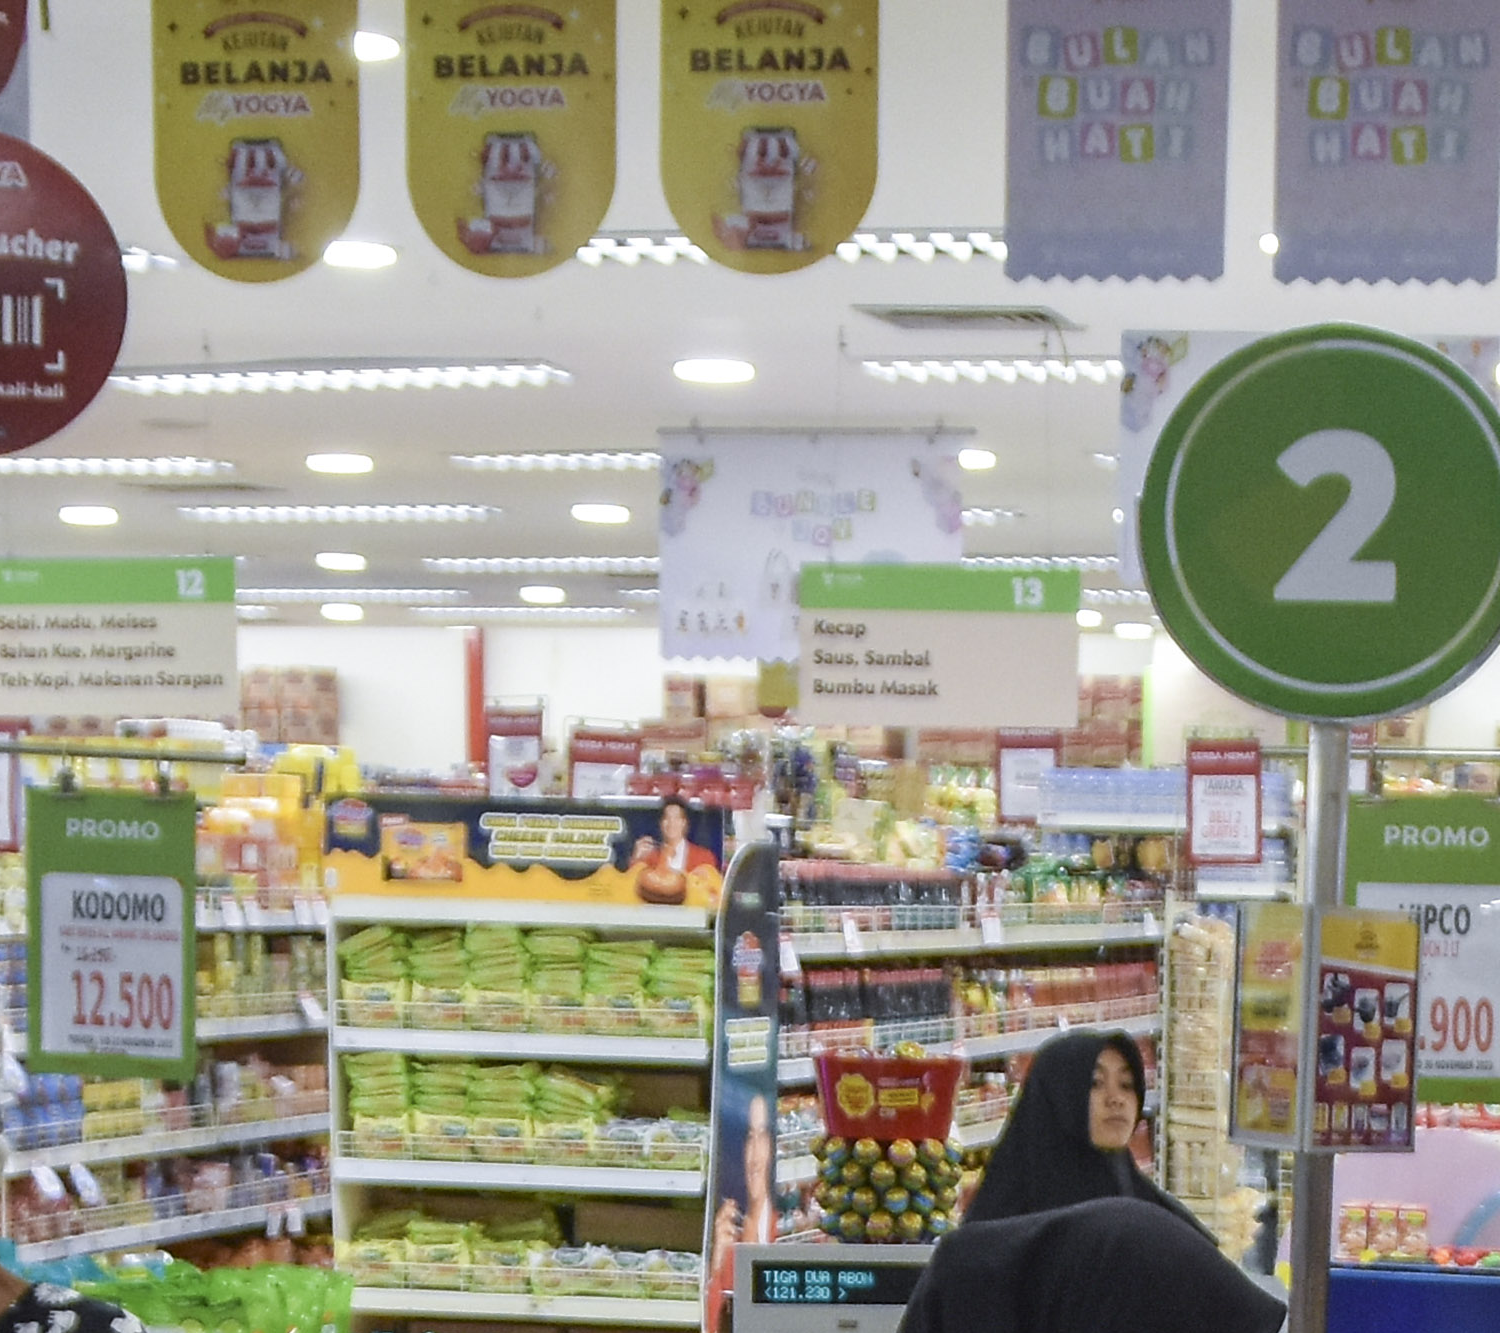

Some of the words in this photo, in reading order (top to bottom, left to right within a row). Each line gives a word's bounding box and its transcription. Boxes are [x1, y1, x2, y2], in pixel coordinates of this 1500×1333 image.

[222, 29, 290, 54] KEJUTAN
[1023, 27, 1213, 69] BULAN
[1294, 27, 1490, 69] BULAN
[435, 53, 589, 79] BELANJA
[689, 46, 851, 73] BELANJA
[180, 59, 332, 86] BELANJA
[232, 93, 311, 116] YOGYA
[485, 87, 564, 109] YOGYA
[1273, 427, 1398, 602] 2
[175, 568, 206, 597] 12
[1011, 576, 1045, 608] 13
[813, 618, 867, 639] Kecap
[0, 642, 48, 659] Bahan
[91, 641, 177, 662] Margarine
[813, 649, 860, 668] Saus,
[864, 649, 931, 668] Sambal
[78, 670, 153, 687] Makanan
[156, 670, 224, 690] Sarapan
[813, 678, 876, 696] Bumbu
[880, 679, 939, 697] Masak
[64, 816, 161, 841] PROMO
[1384, 825, 1490, 848] PROMO
[71, 889, 166, 923] KODOMO
[70, 968, 175, 1031] 12.500
[1418, 996, 1495, 1052] .900
[762, 1269, 799, 1285] TIGA
